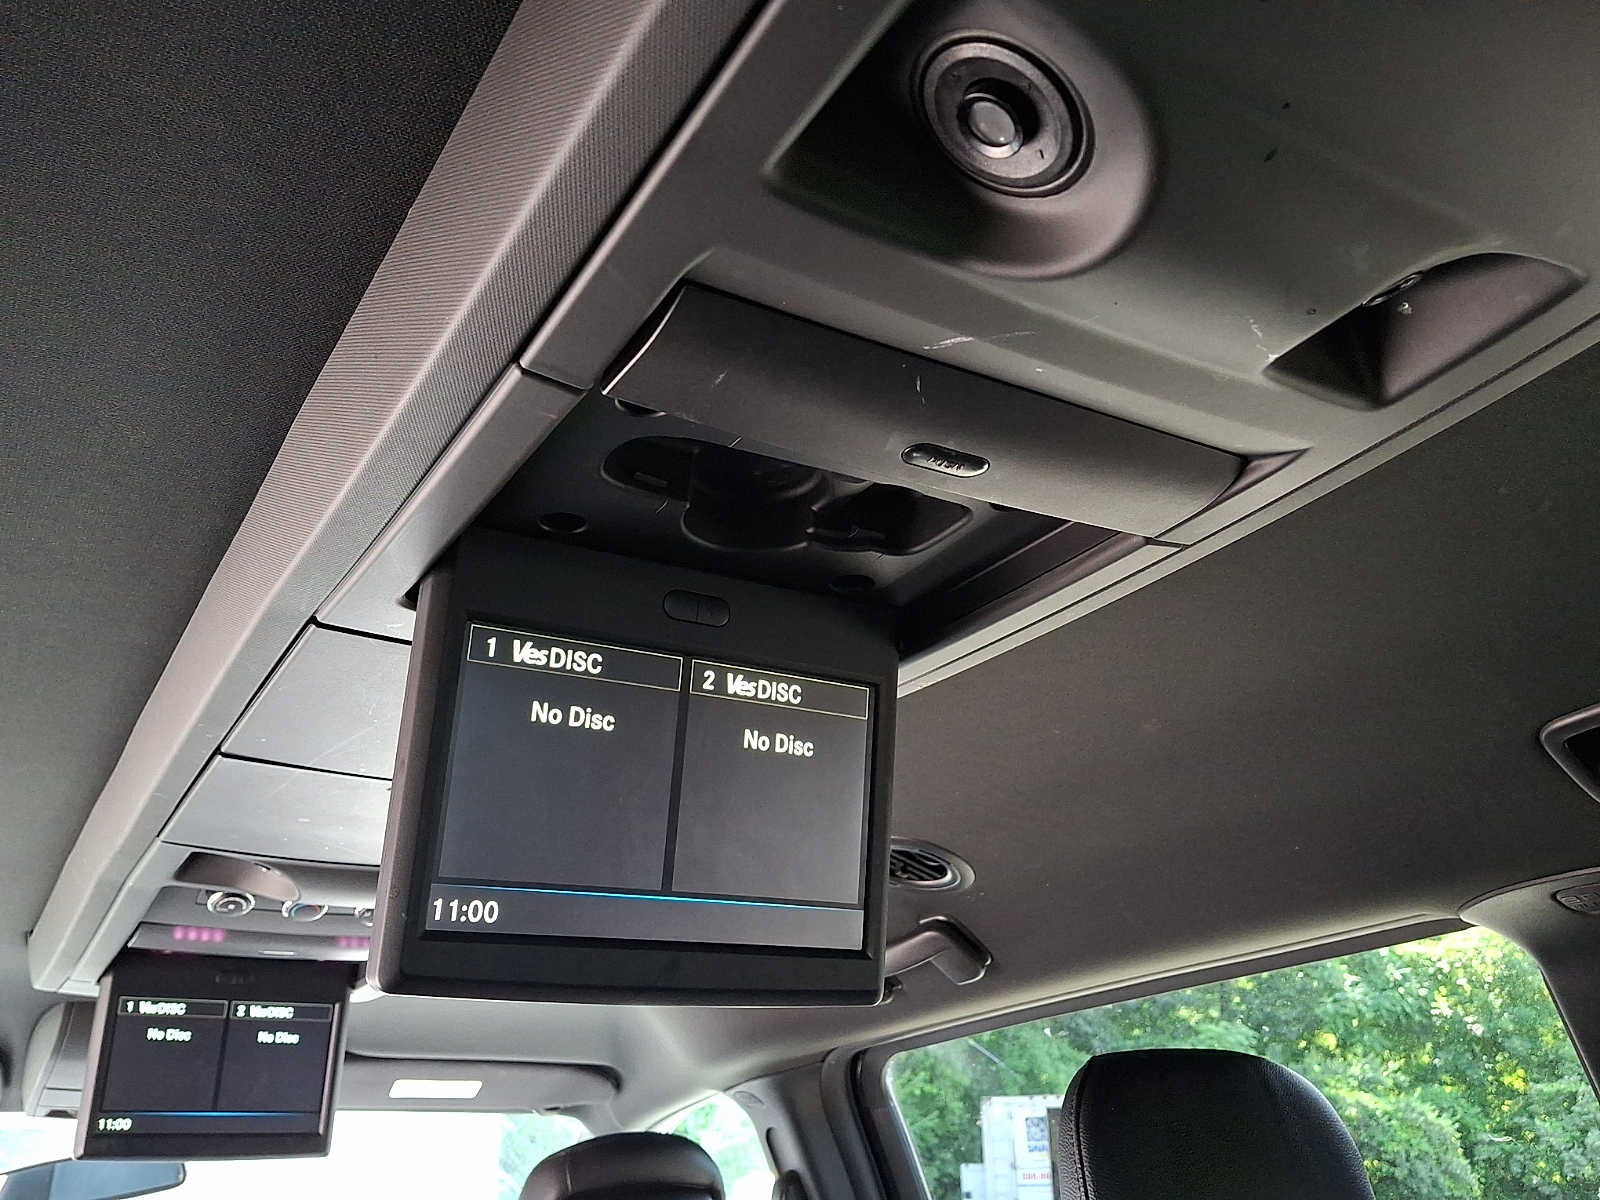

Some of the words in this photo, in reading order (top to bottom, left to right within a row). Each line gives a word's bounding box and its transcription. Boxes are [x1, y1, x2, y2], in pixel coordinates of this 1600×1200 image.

[487, 636, 497, 658] 1
[702, 670, 716, 691] 2
[530, 700, 563, 725] No
[568, 705, 616, 732] Disc
[743, 728, 771, 751] No
[774, 732, 814, 758] Disc
[433, 897, 499, 924] 11:00
[146, 1027, 166, 1041] No
[165, 1028, 192, 1042] Disc
[98, 1117, 133, 1131] 11:00
